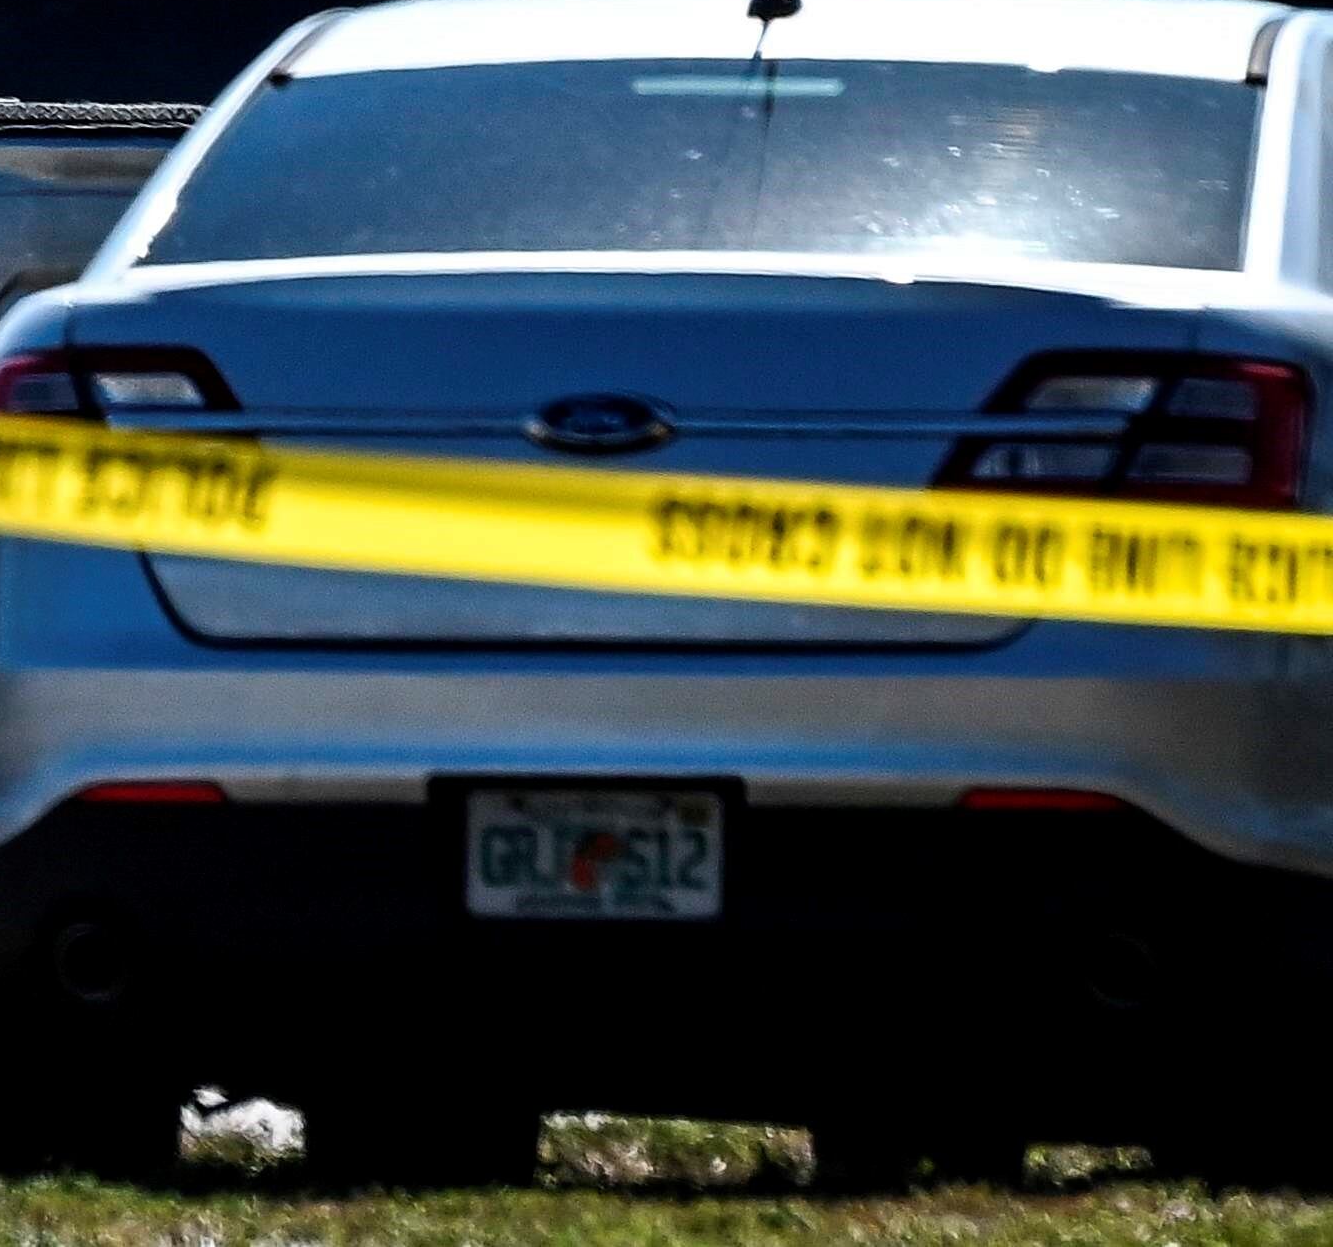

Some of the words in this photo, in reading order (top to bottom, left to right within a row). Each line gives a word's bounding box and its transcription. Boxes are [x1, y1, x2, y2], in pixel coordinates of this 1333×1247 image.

[80, 446, 275, 529] POLICE
[650, 496, 836, 573] CROSS
[859, 513, 968, 579] NOT
[994, 519, 1061, 586] DO
[1090, 527, 1203, 598] LINE
